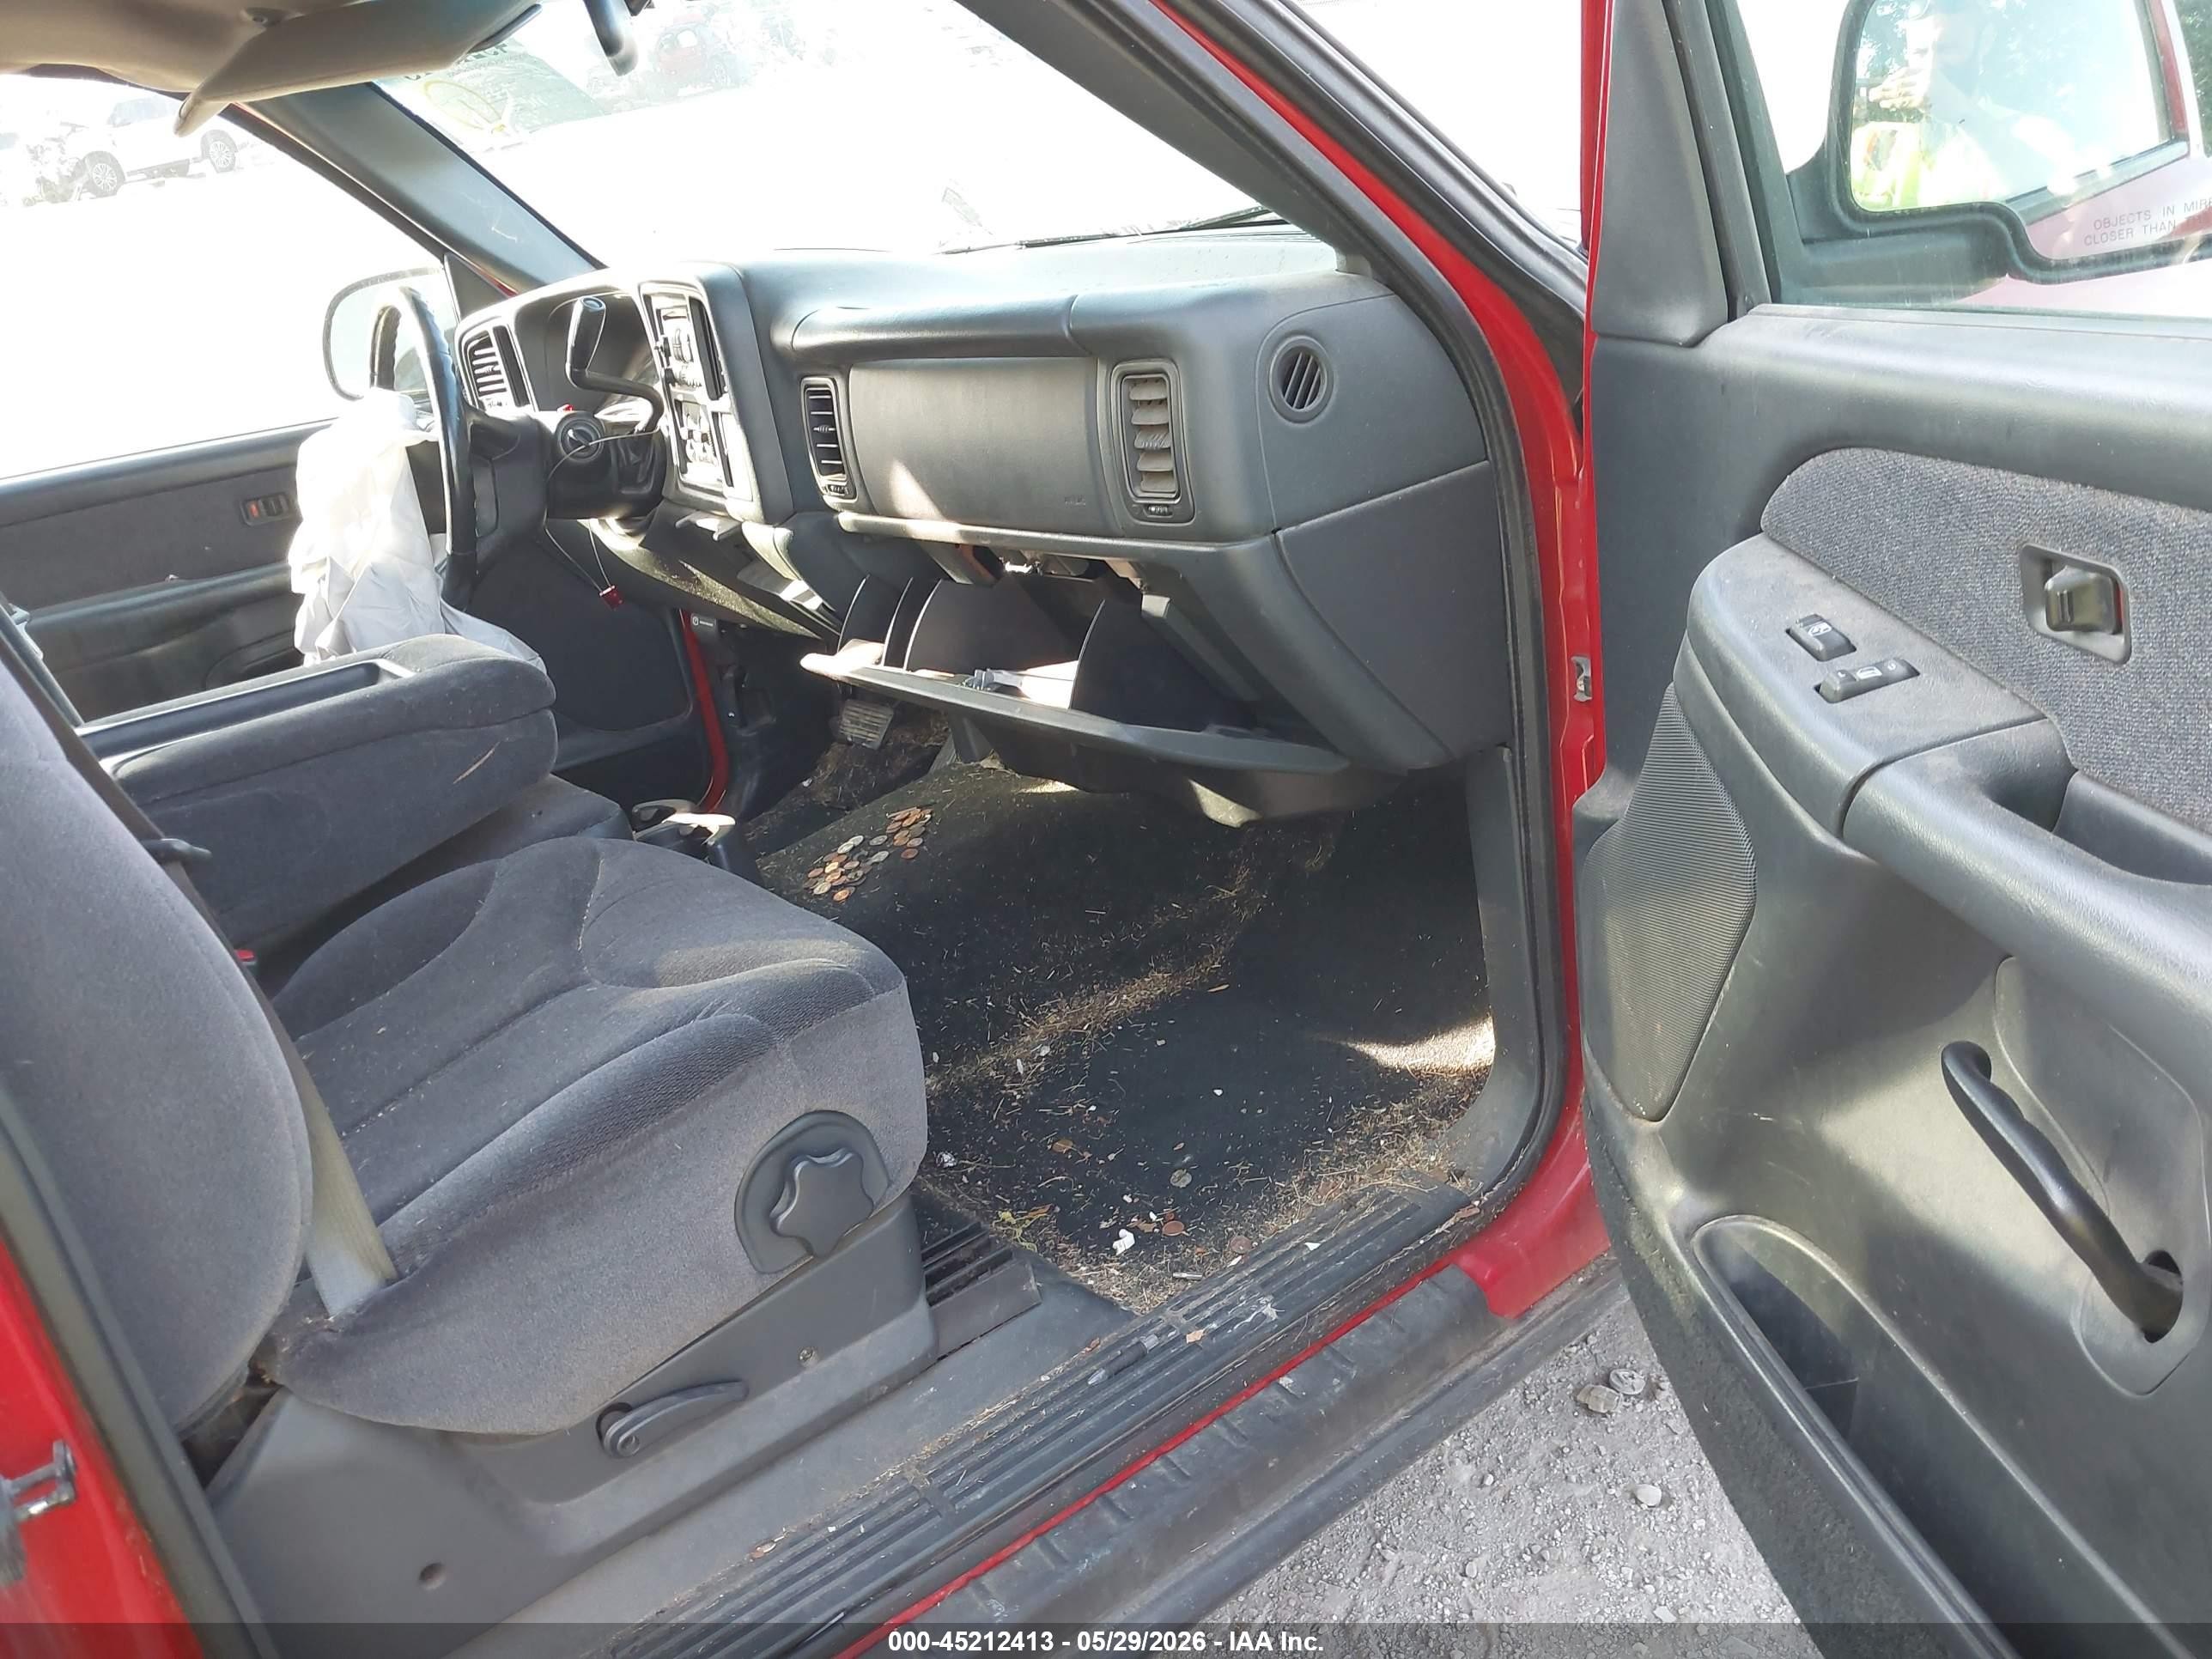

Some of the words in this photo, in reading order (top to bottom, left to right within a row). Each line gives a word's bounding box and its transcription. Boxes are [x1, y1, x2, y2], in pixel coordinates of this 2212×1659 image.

[2093, 210, 2152, 231] OBJECTS
[2162, 205, 2175, 217] IN
[2083, 227, 2135, 246] CLOSER
[2142, 219, 2177, 234] THAN
